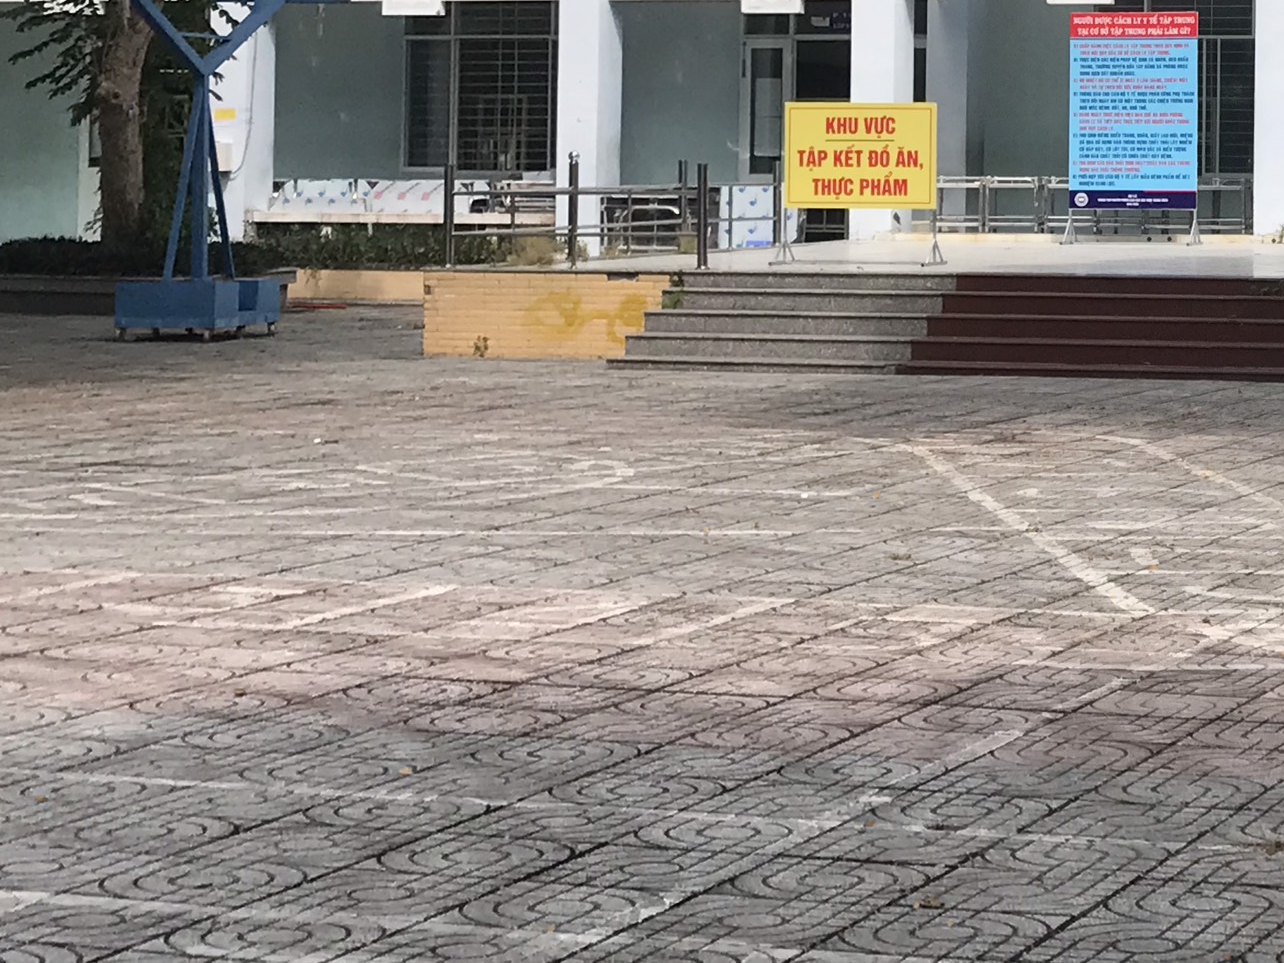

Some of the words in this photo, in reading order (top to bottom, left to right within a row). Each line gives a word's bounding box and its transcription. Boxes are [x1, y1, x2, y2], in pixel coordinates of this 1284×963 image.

[1114, 15, 1131, 25] CÁCH
[1133, 17, 1141, 25] LY
[1159, 15, 1172, 26] TẬP
[1174, 16, 1195, 25] TRUNG
[825, 117, 859, 135] KHU
[864, 116, 896, 139] VỰC
[797, 146, 828, 172] TẬP
[833, 144, 863, 168] KẾT
[895, 147, 923, 170] ĂN,
[813, 176, 854, 200] THỰC
[859, 171, 908, 197] PHẨM
